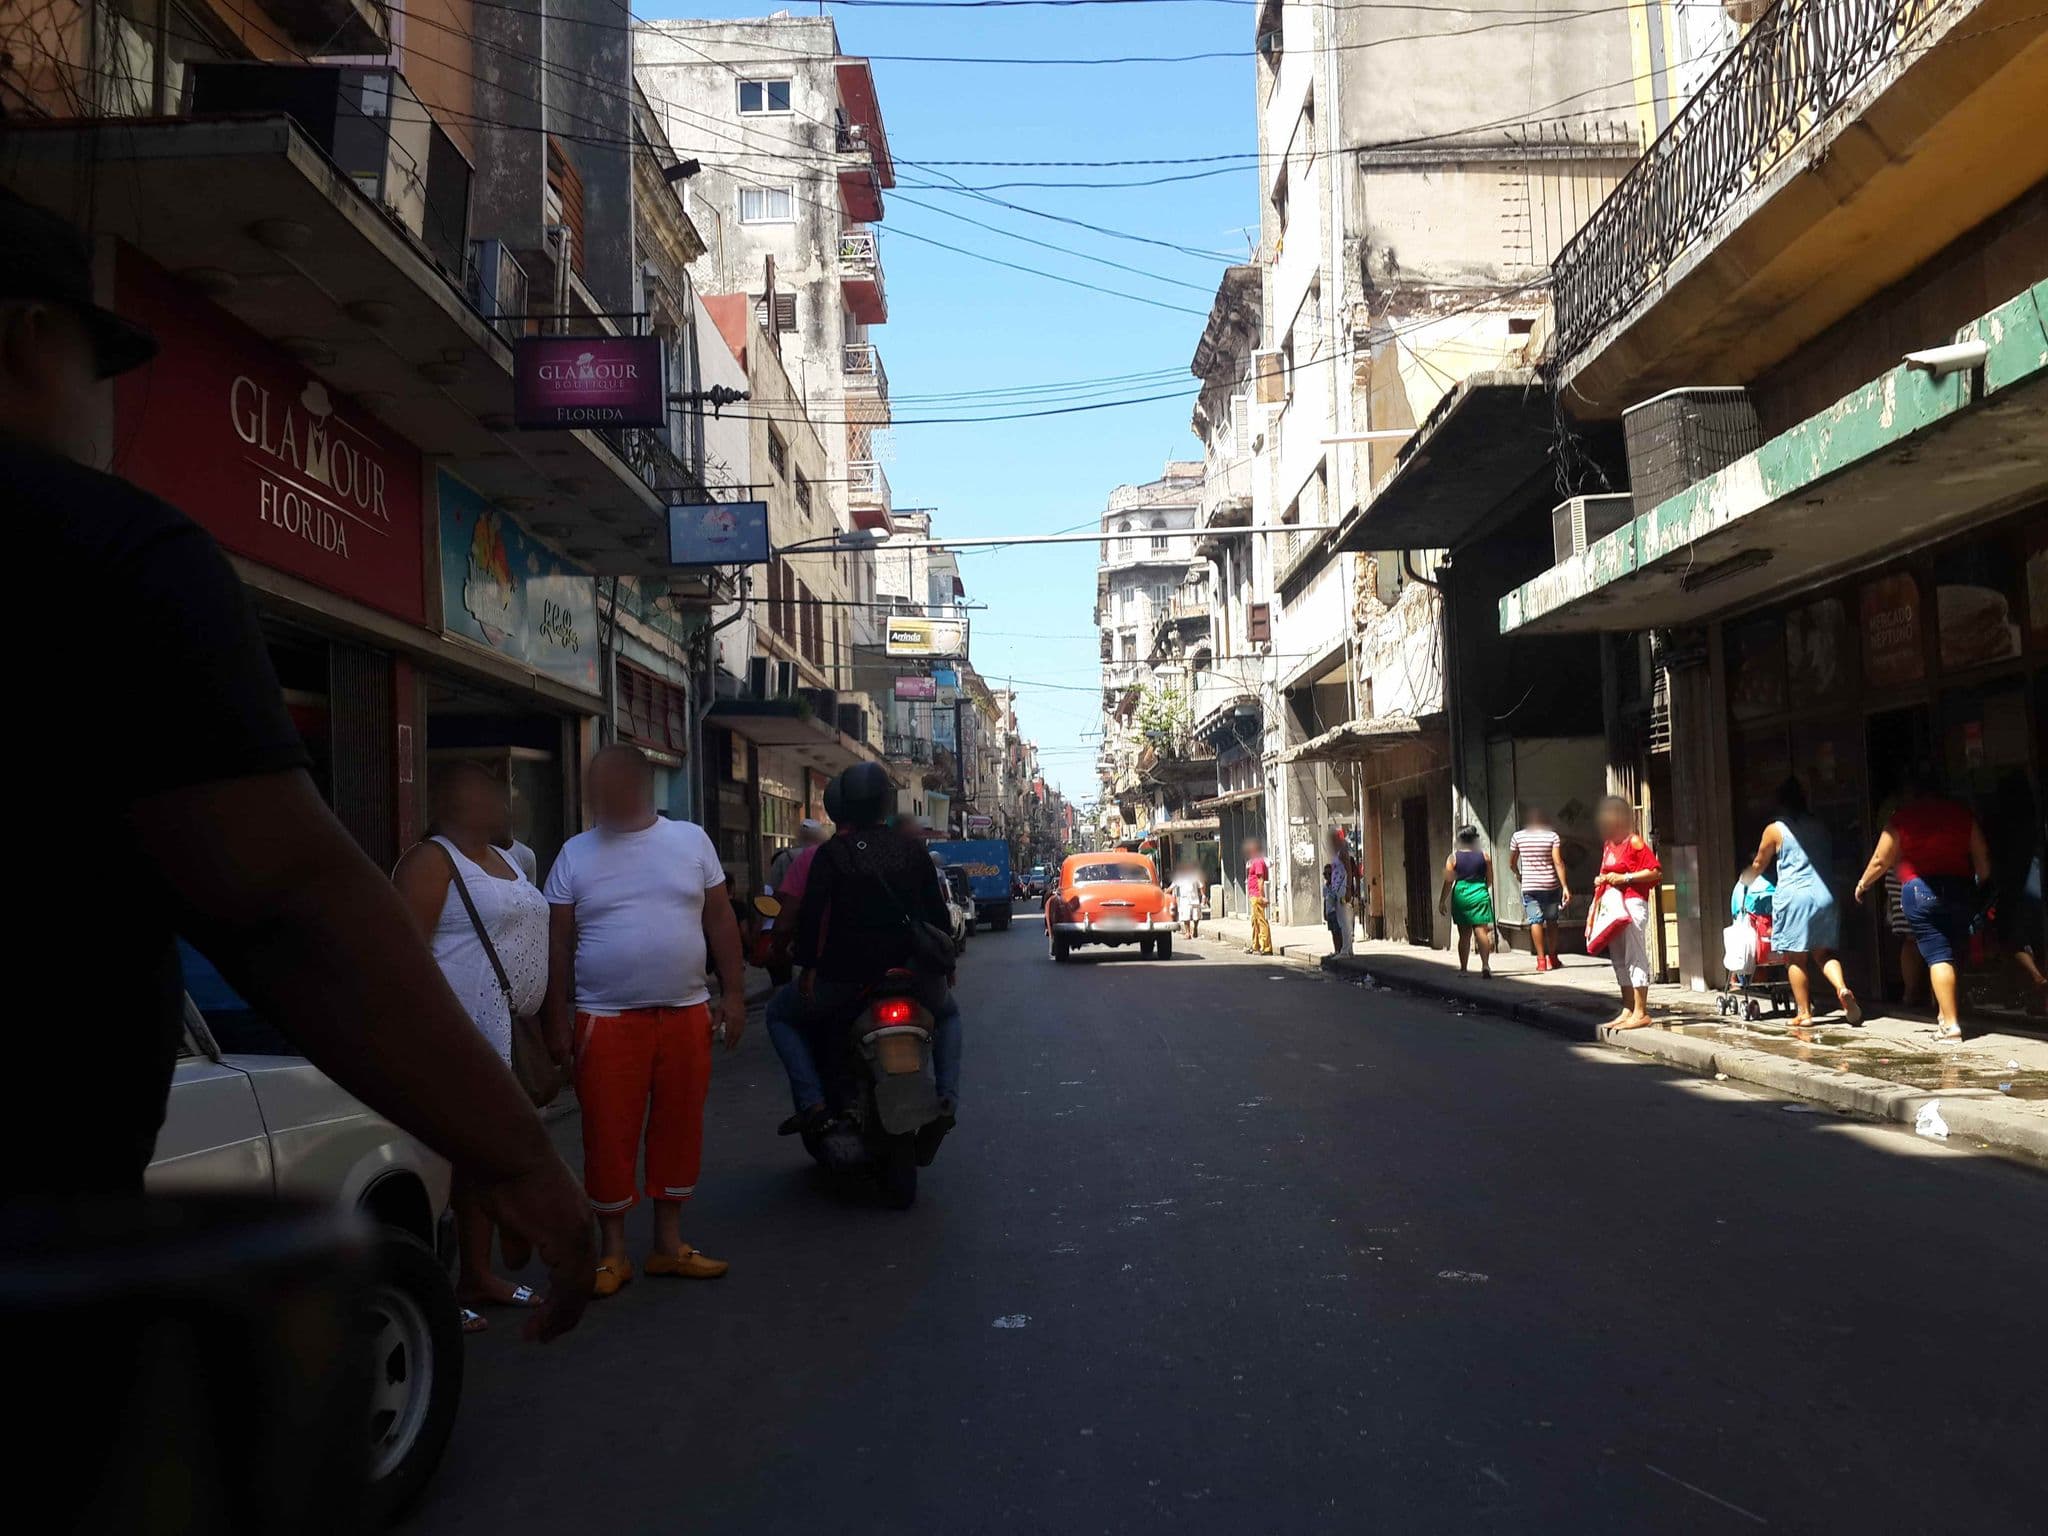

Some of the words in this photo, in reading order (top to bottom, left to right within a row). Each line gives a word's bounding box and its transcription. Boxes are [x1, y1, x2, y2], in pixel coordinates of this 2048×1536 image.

[537, 364, 639, 380] GLAMOUR
[554, 379, 625, 390] BOUTIQUE
[556, 407, 624, 421] FLORIDA
[230, 375, 391, 523] GLAMOUR
[259, 478, 350, 560] FLORIDA
